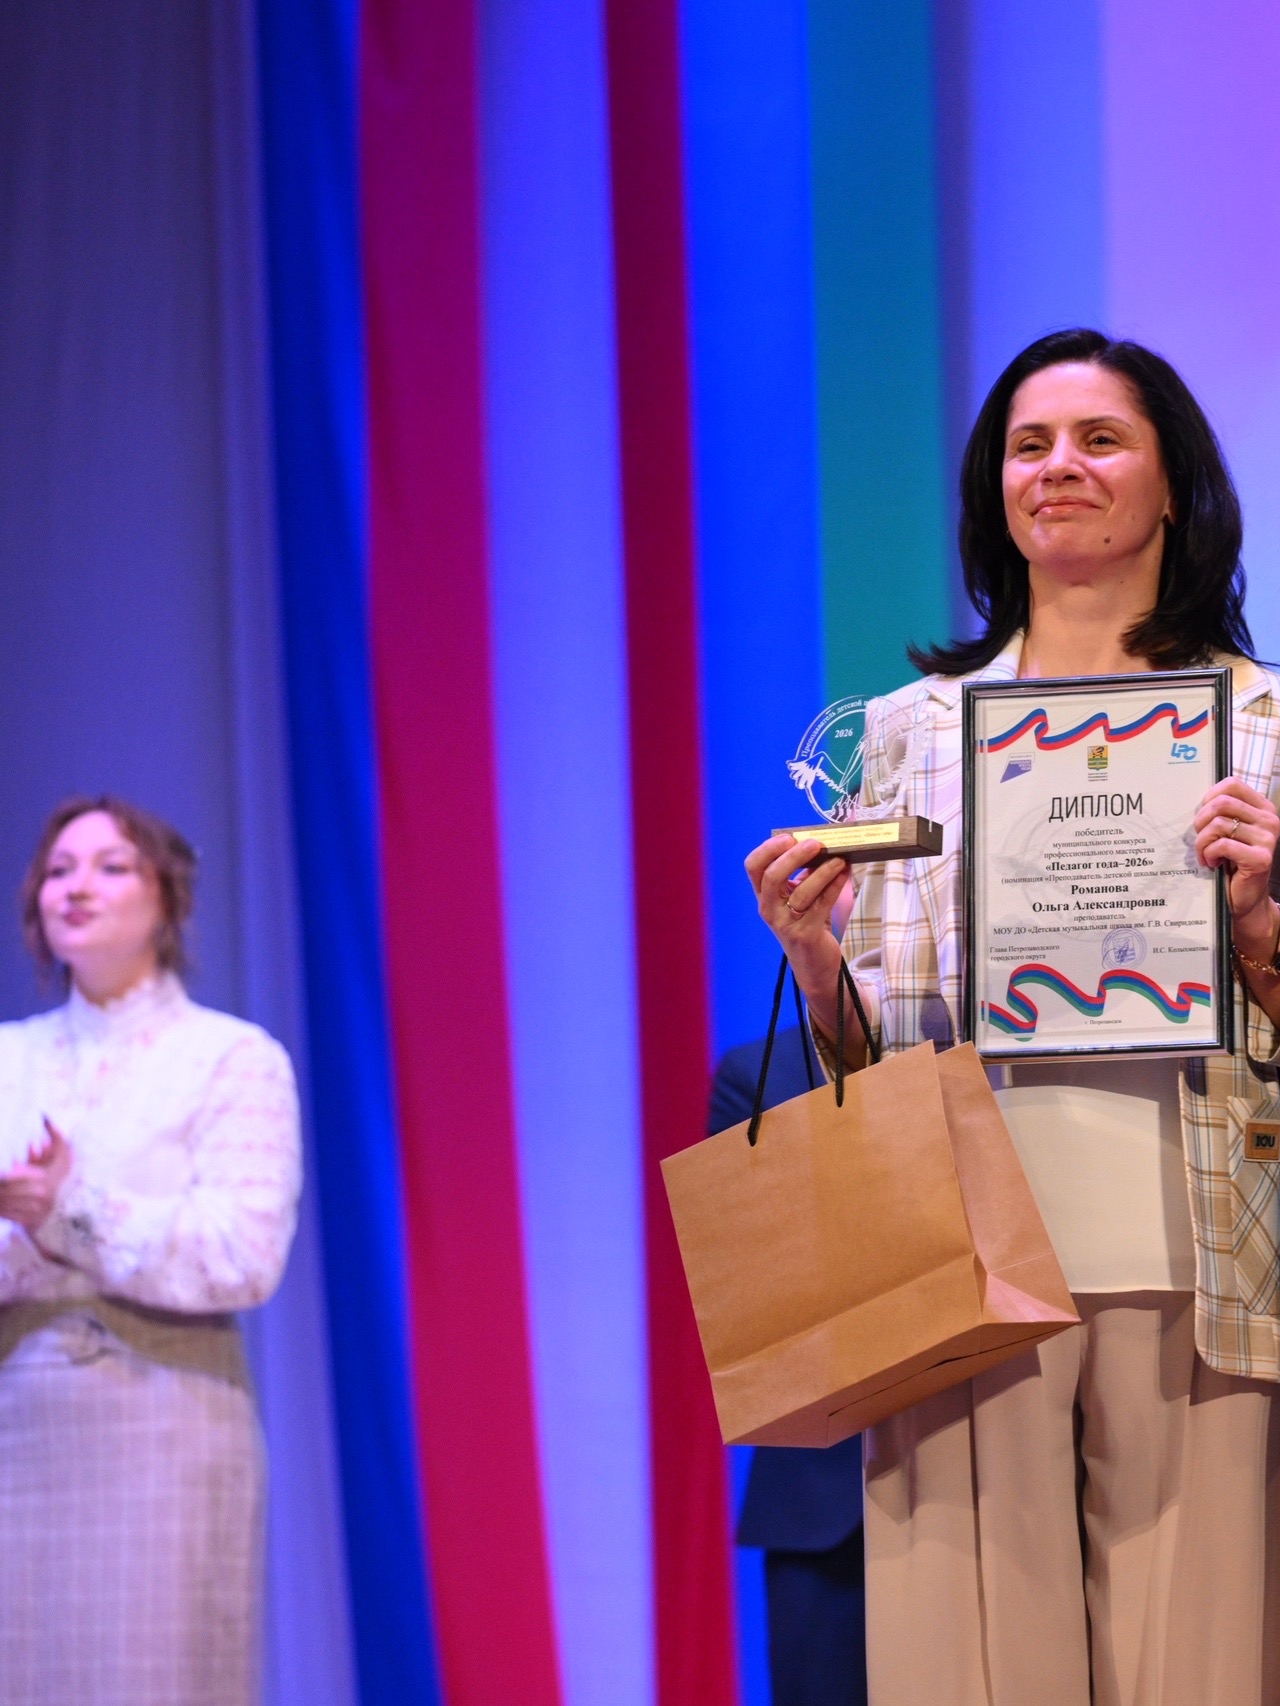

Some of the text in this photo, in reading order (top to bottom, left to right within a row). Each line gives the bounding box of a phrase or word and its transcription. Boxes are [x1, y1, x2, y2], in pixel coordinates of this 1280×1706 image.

[834, 728, 854, 739] 2026
[1048, 792, 1143, 823] ДИПЛОМ
[1075, 828, 1124, 837] победитель
[1052, 838, 1147, 850] муниципального конкурса
[1043, 847, 1155, 860] профессионального мастерства
[1045, 861, 1093, 872] «Педагог
[1044, 874, 1102, 884] «Преподаватель
[1103, 871, 1132, 880] детской
[1071, 883, 1129, 895] Романова
[1032, 901, 1070, 913] Ольга
[1073, 913, 1126, 922] преподаватель
[993, 927, 1013, 936] МОУ
[1014, 926, 1027, 936] ДО
[1027, 925, 1061, 934] «Детская
[1062, 923, 1108, 933] музыкальная
[1109, 921, 1133, 930] школа
